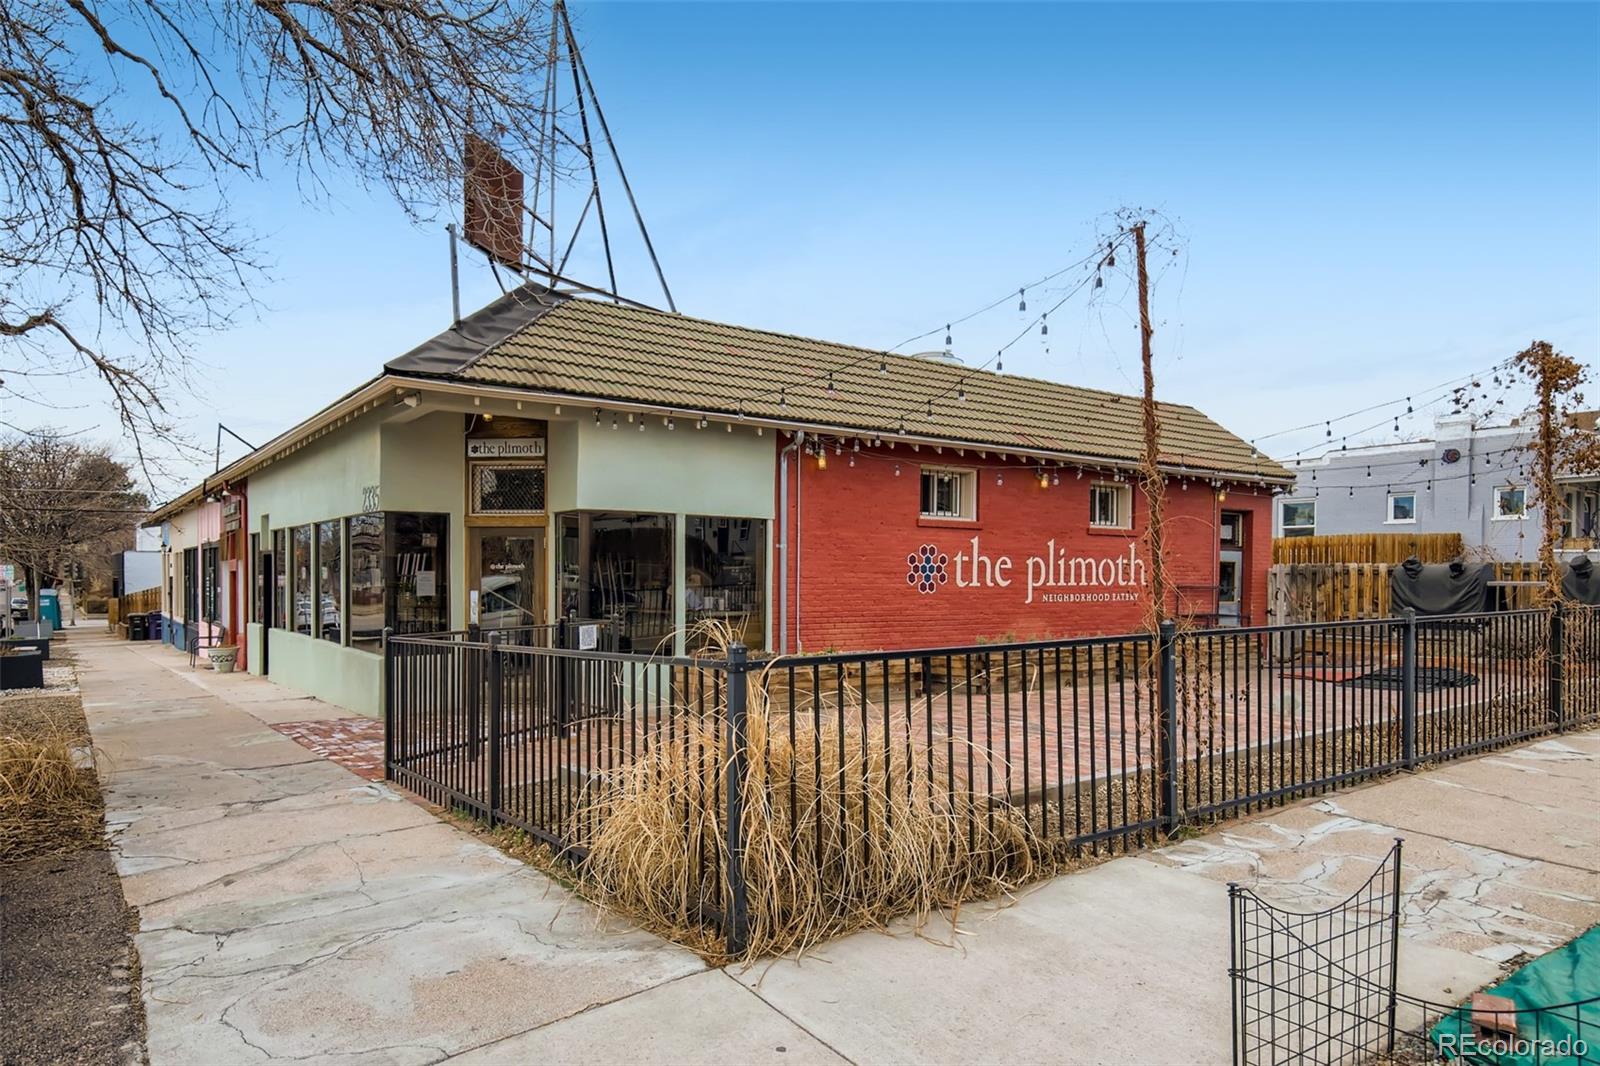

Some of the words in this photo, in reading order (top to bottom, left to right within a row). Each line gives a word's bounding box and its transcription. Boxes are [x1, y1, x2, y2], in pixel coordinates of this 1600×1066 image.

[479, 441, 496, 454] the
[497, 440, 542, 458] plimoth
[953, 535, 1013, 588] the
[1024, 538, 1148, 604] plimoth
[1042, 593, 1110, 602] NEIGHBORHOOD
